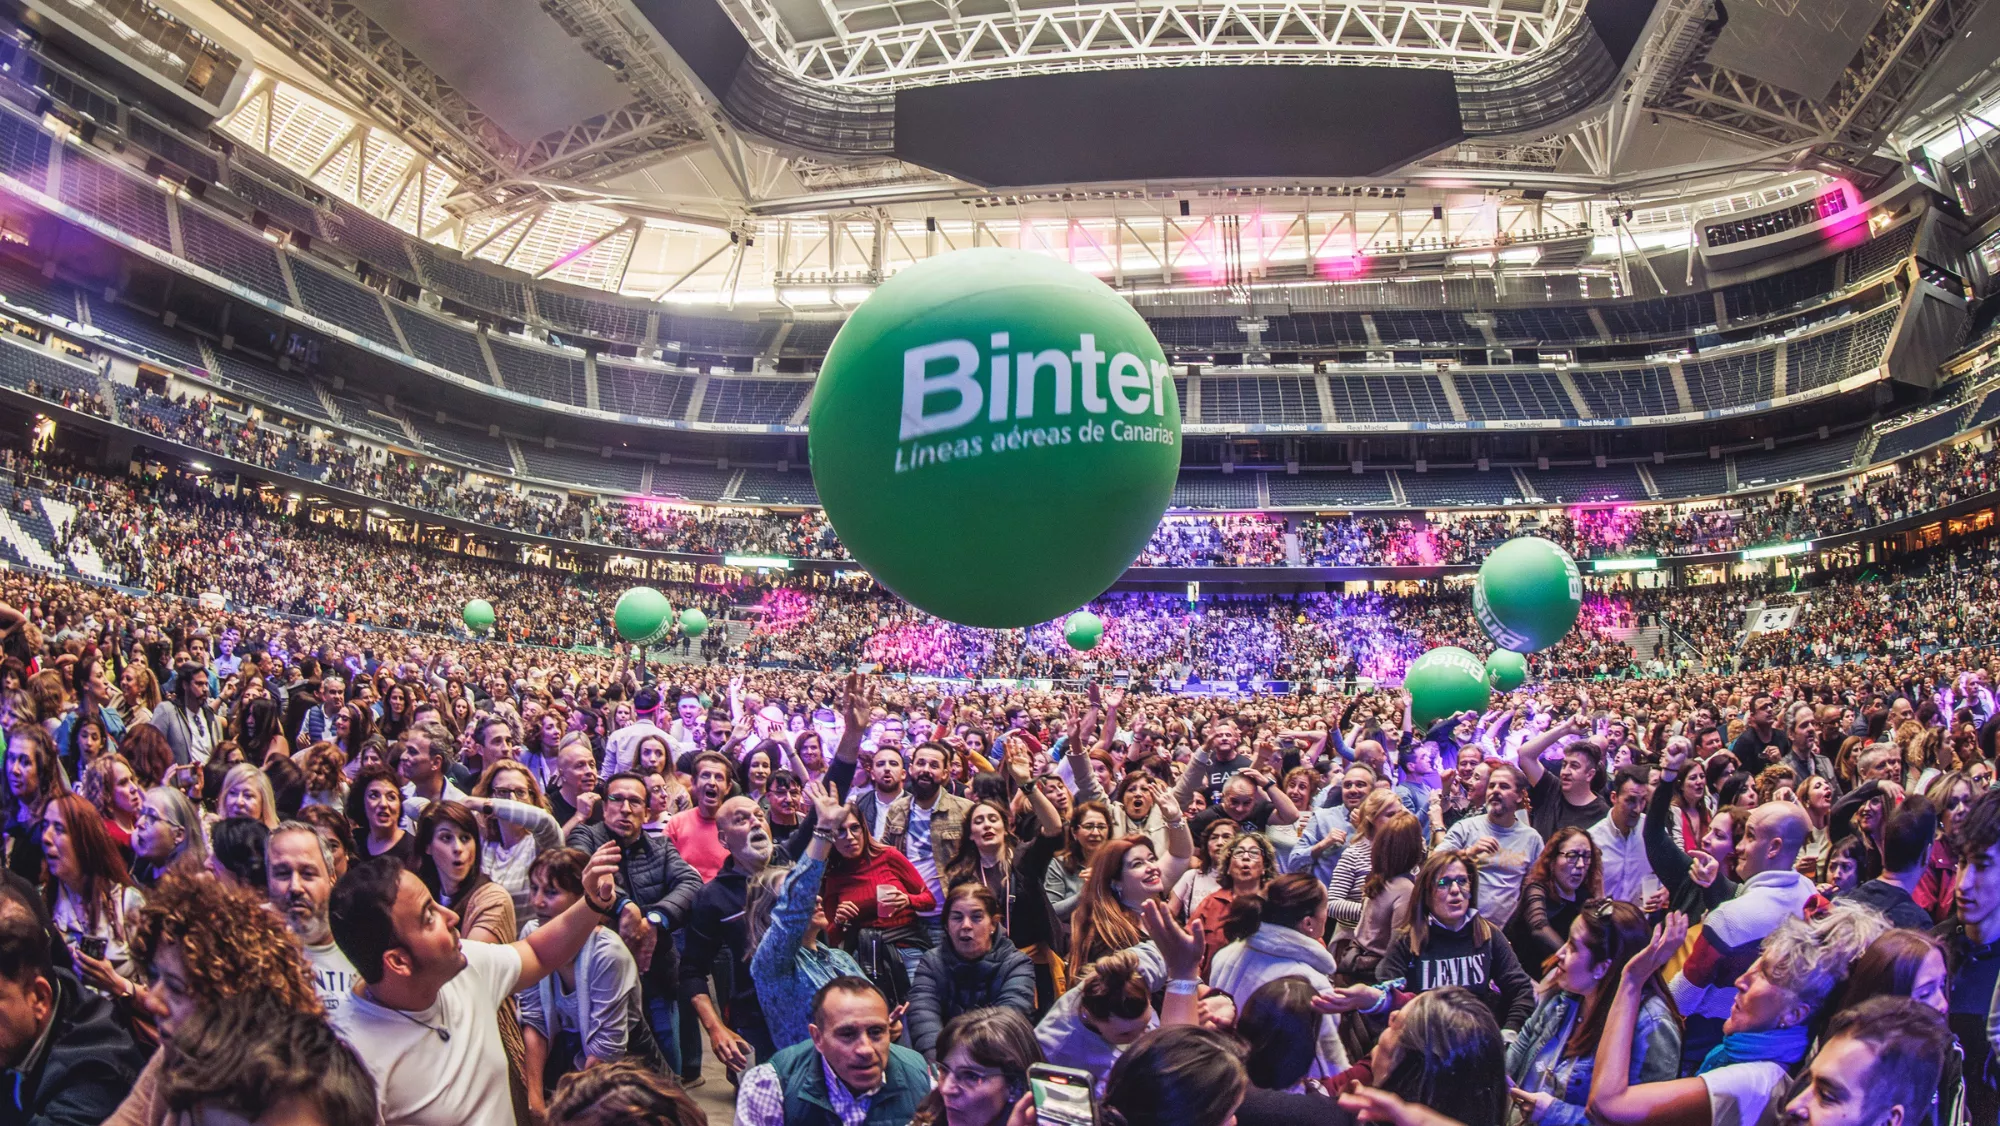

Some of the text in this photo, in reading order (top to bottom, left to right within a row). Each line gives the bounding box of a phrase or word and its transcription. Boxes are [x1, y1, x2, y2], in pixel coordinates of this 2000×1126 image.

[155, 251, 195, 276] Real Madrid
[302, 315, 339, 336] Real Madrid
[899, 331, 1170, 441] Binter
[1788, 389, 1824, 403] Real Madrid
[1720, 404, 1756, 416] Real Madrid
[637, 416, 676, 428] Real Madrid
[1427, 421, 1467, 430] Real Madrid
[1578, 418, 1615, 427] Real Madrid
[1649, 415, 1687, 425] Real Madrid
[711, 424, 749, 433] Real Madrid
[784, 424, 800, 433] Real
[1265, 423, 1308, 432] Real Madrid
[895, 419, 1174, 474] Líneas aéreas de Canarias
[1419, 653, 1485, 683] Binter
[1421, 954, 1485, 990] LEVI'S
